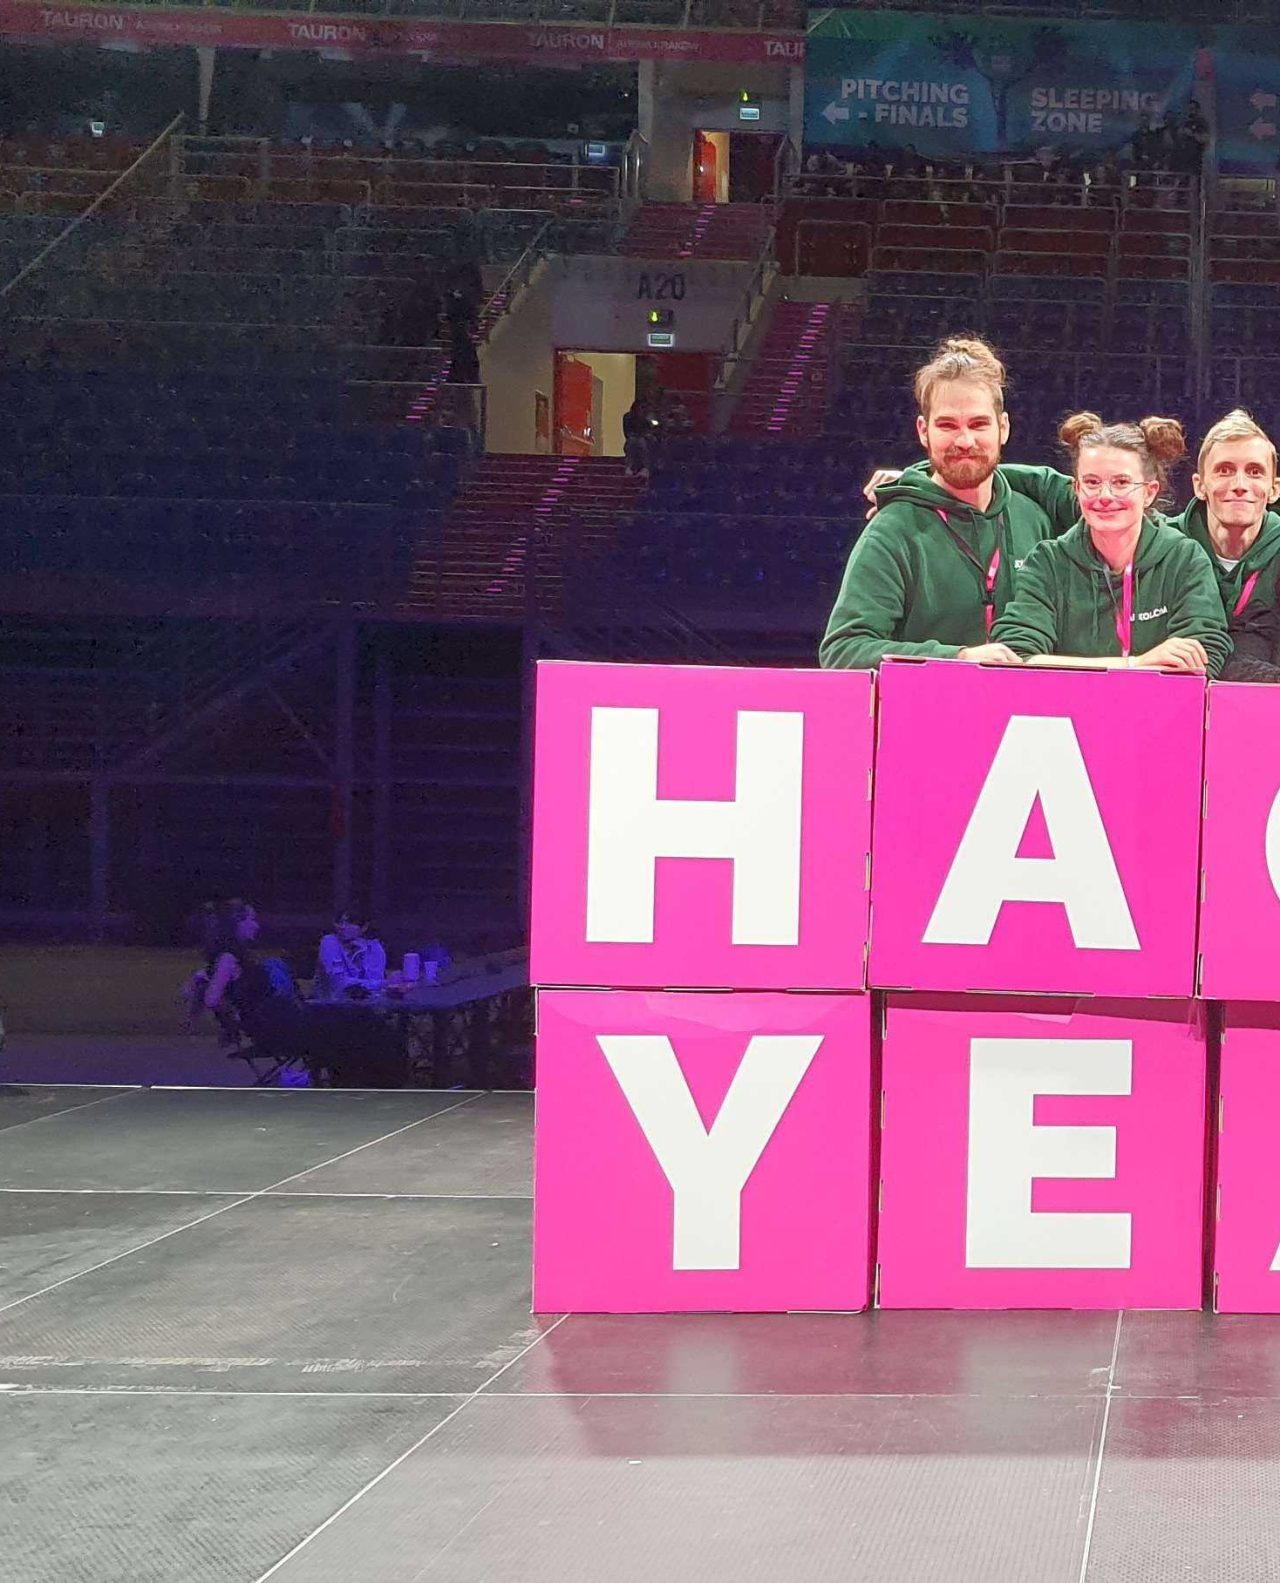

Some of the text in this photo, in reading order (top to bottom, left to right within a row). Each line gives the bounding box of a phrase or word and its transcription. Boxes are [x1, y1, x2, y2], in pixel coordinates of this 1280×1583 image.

[40, 11, 124, 30] TAURON
[288, 23, 366, 41] TAURON
[528, 32, 604, 49] TAURON
[841, 78, 969, 104] PITCHING
[1031, 87, 1161, 113] SLEEPING
[875, 103, 968, 128] FINALS
[1031, 111, 1102, 133] ZONE
[637, 273, 686, 300] A20
